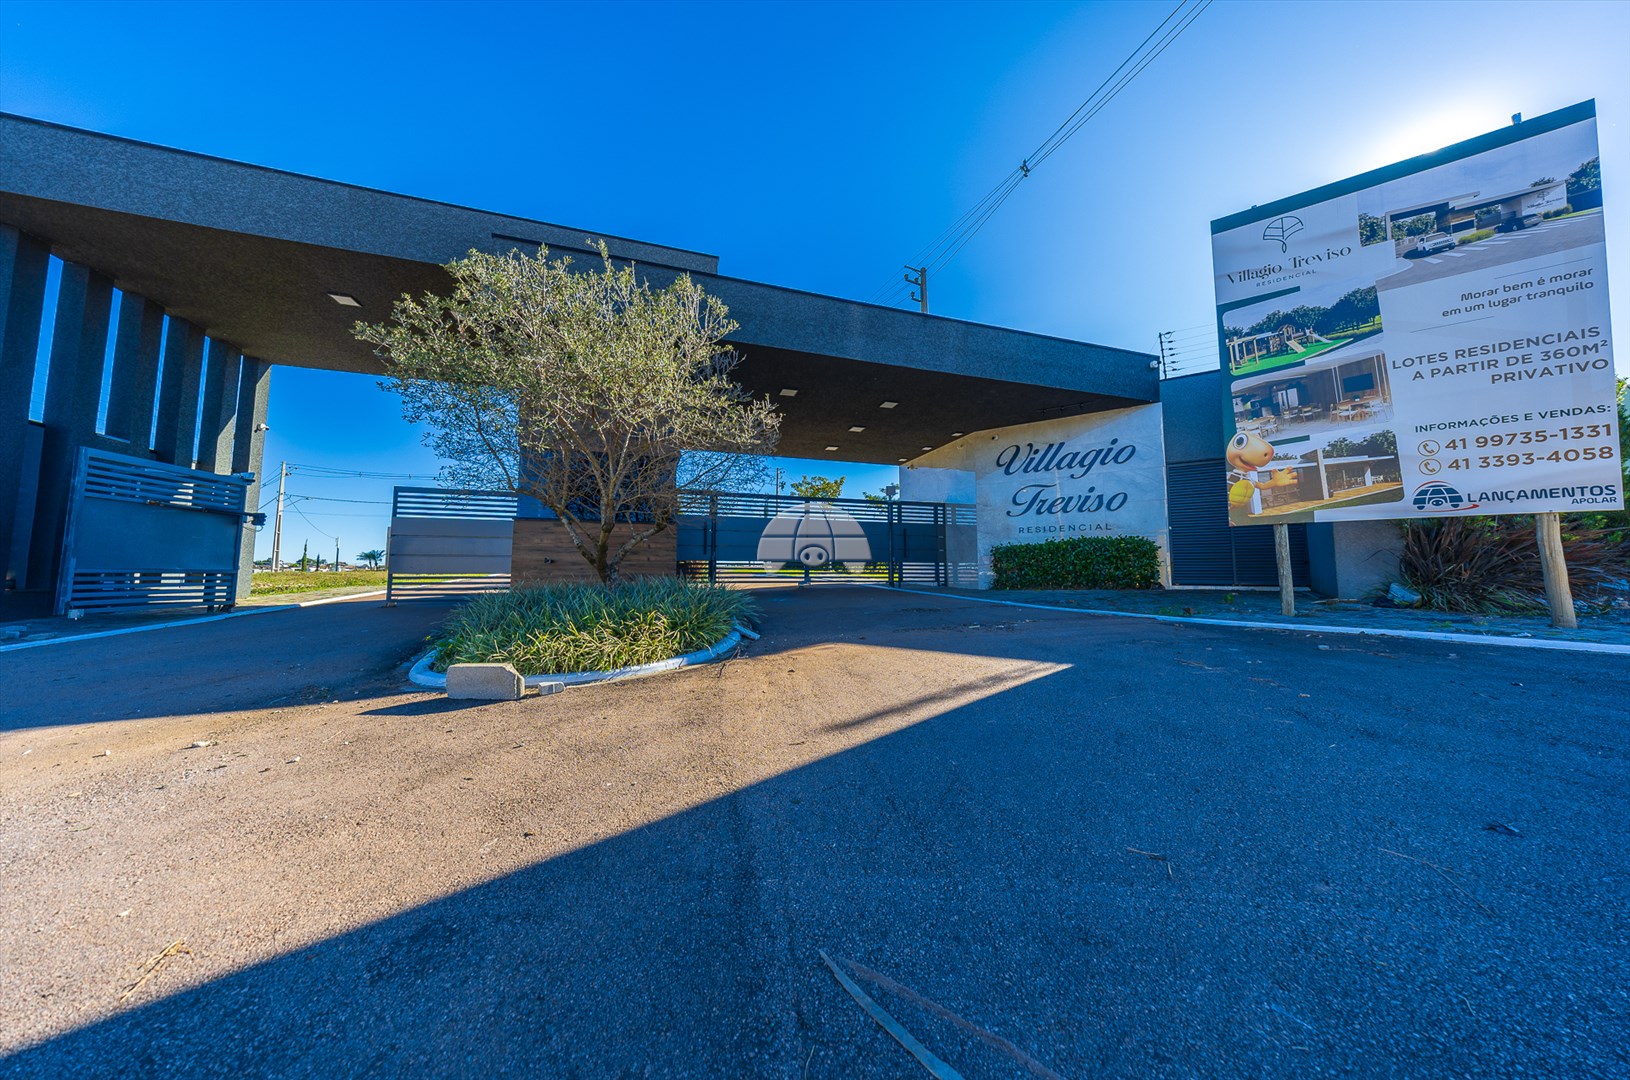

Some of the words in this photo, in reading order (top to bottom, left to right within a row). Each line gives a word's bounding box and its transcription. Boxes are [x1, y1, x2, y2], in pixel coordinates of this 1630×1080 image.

[1227, 263, 1282, 285] Villagio
[1288, 246, 1352, 269] Treviso
[1256, 269, 1317, 287] RESIDENCIAL
[1442, 307, 1461, 317] em
[1465, 302, 1485, 313] um
[1488, 295, 1522, 308] lugar
[1526, 280, 1594, 301] tranquilo
[1461, 287, 1500, 302] Morar
[1503, 280, 1533, 293] bem
[1537, 276, 1546, 286] é
[1549, 268, 1593, 283] morar
[1392, 352, 1448, 370] LOTES
[1455, 326, 1600, 360] RESIDENCIAIS
[1412, 370, 1425, 381] A
[1431, 358, 1499, 378] PARTIR
[1506, 353, 1533, 367] DE
[1491, 358, 1609, 384] PRIVATIVO
[1415, 414, 1519, 433] INFORMAÇÕES
[1524, 412, 1533, 421] E
[1538, 404, 1611, 419] VENDAS:
[1445, 437, 1467, 451] 41
[1475, 423, 1612, 448] 99735-1331
[996, 438, 1136, 479] Villagio
[1447, 458, 1470, 471] 41
[1478, 446, 1614, 469] 3393-4058
[1006, 483, 1128, 517] Treviso
[1467, 484, 1617, 504] LANÇAMENTOS
[1571, 496, 1618, 505] APOLAR
[1018, 523, 1113, 534] RESIDENCIAL
